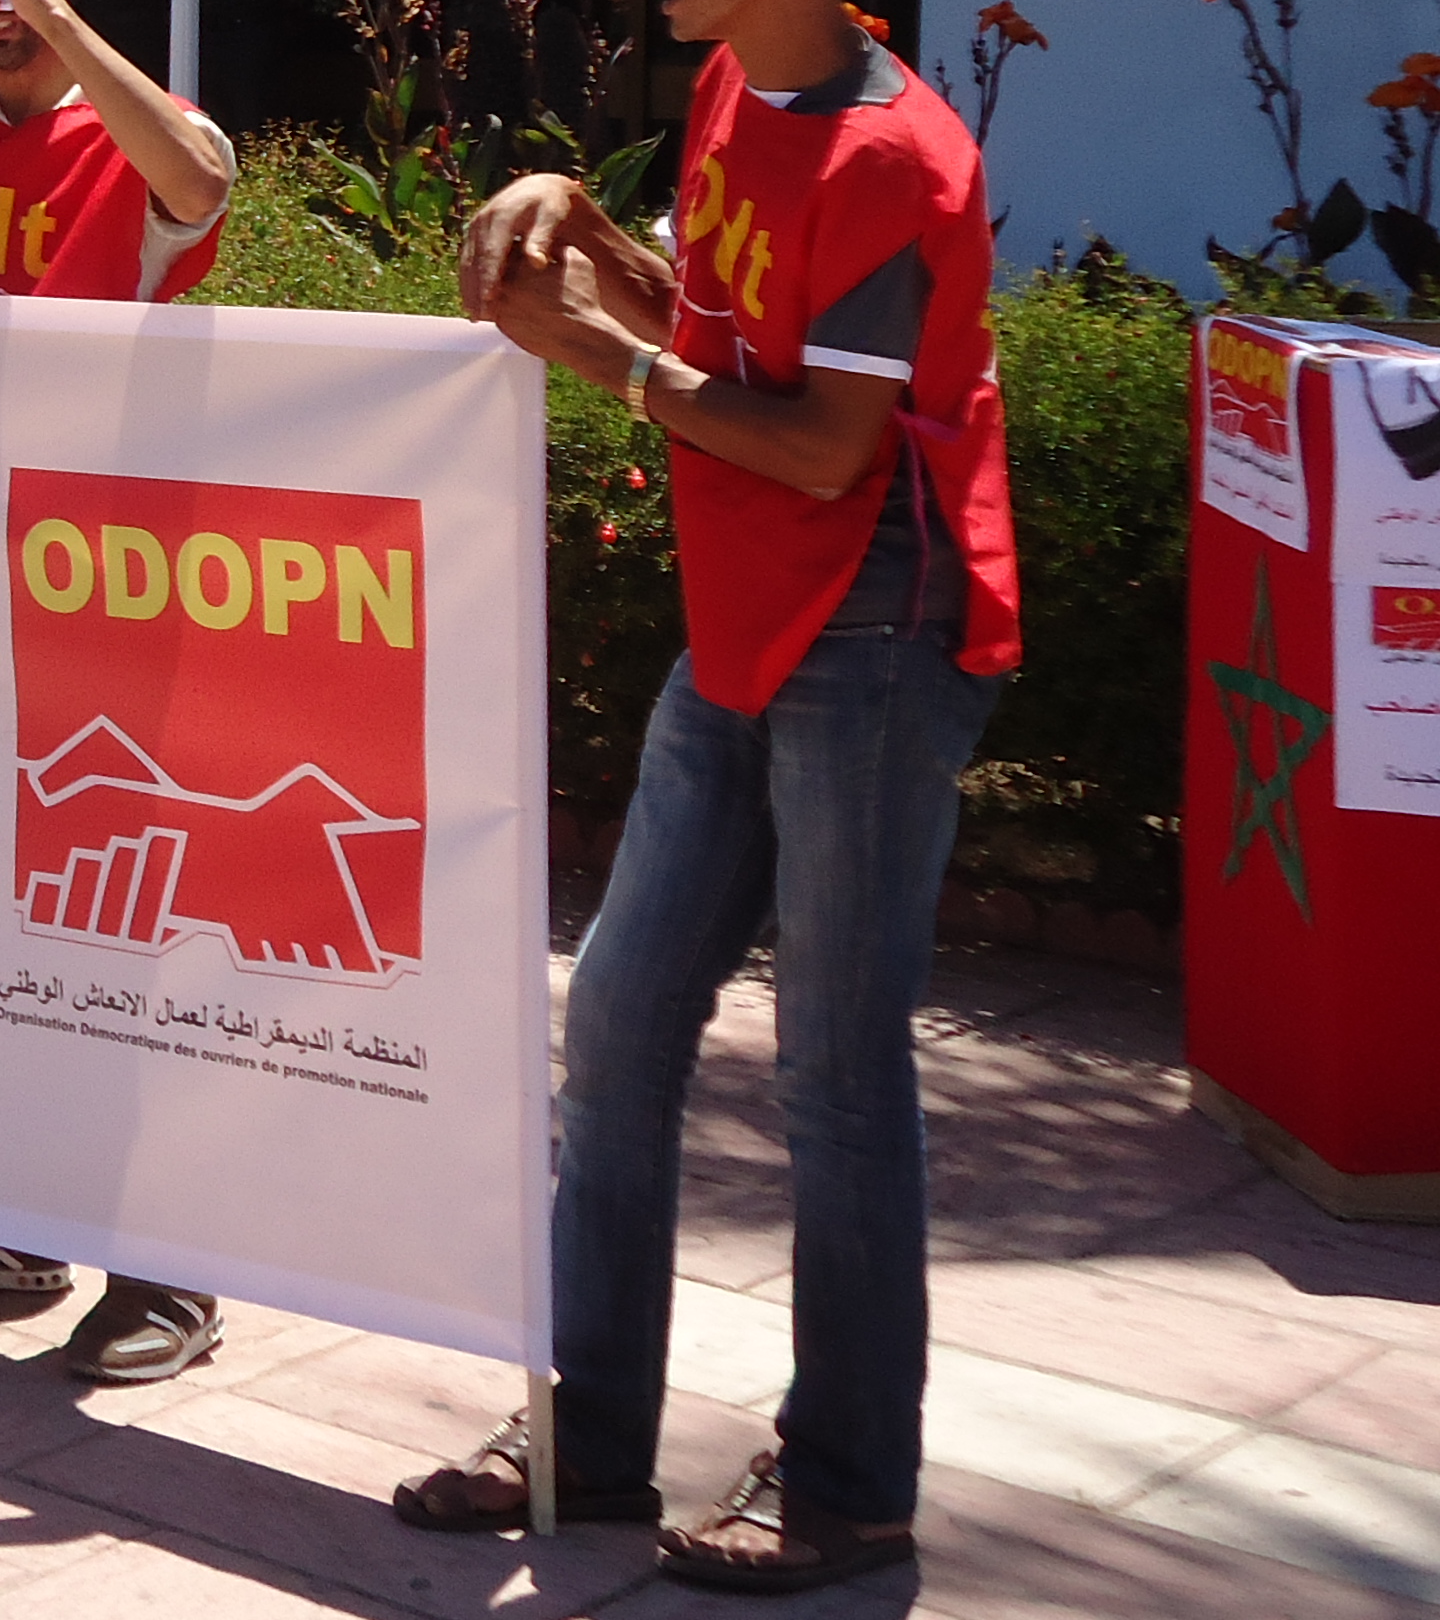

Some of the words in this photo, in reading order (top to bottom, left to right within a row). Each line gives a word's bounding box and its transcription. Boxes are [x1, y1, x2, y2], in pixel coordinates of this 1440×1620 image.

[22, 517, 417, 651] ODOPN
[154, 996, 209, 1029] لعمال
[213, 1003, 334, 1055] الديمقراطية
[79, 1021, 171, 1053] Démocratique
[172, 1041, 198, 1060] des
[199, 1048, 258, 1071] ouvriers
[260, 1058, 280, 1075] de
[282, 1064, 357, 1090] promotion
[359, 1079, 430, 1105] nationale
[342, 1027, 428, 1071] المنظمة
